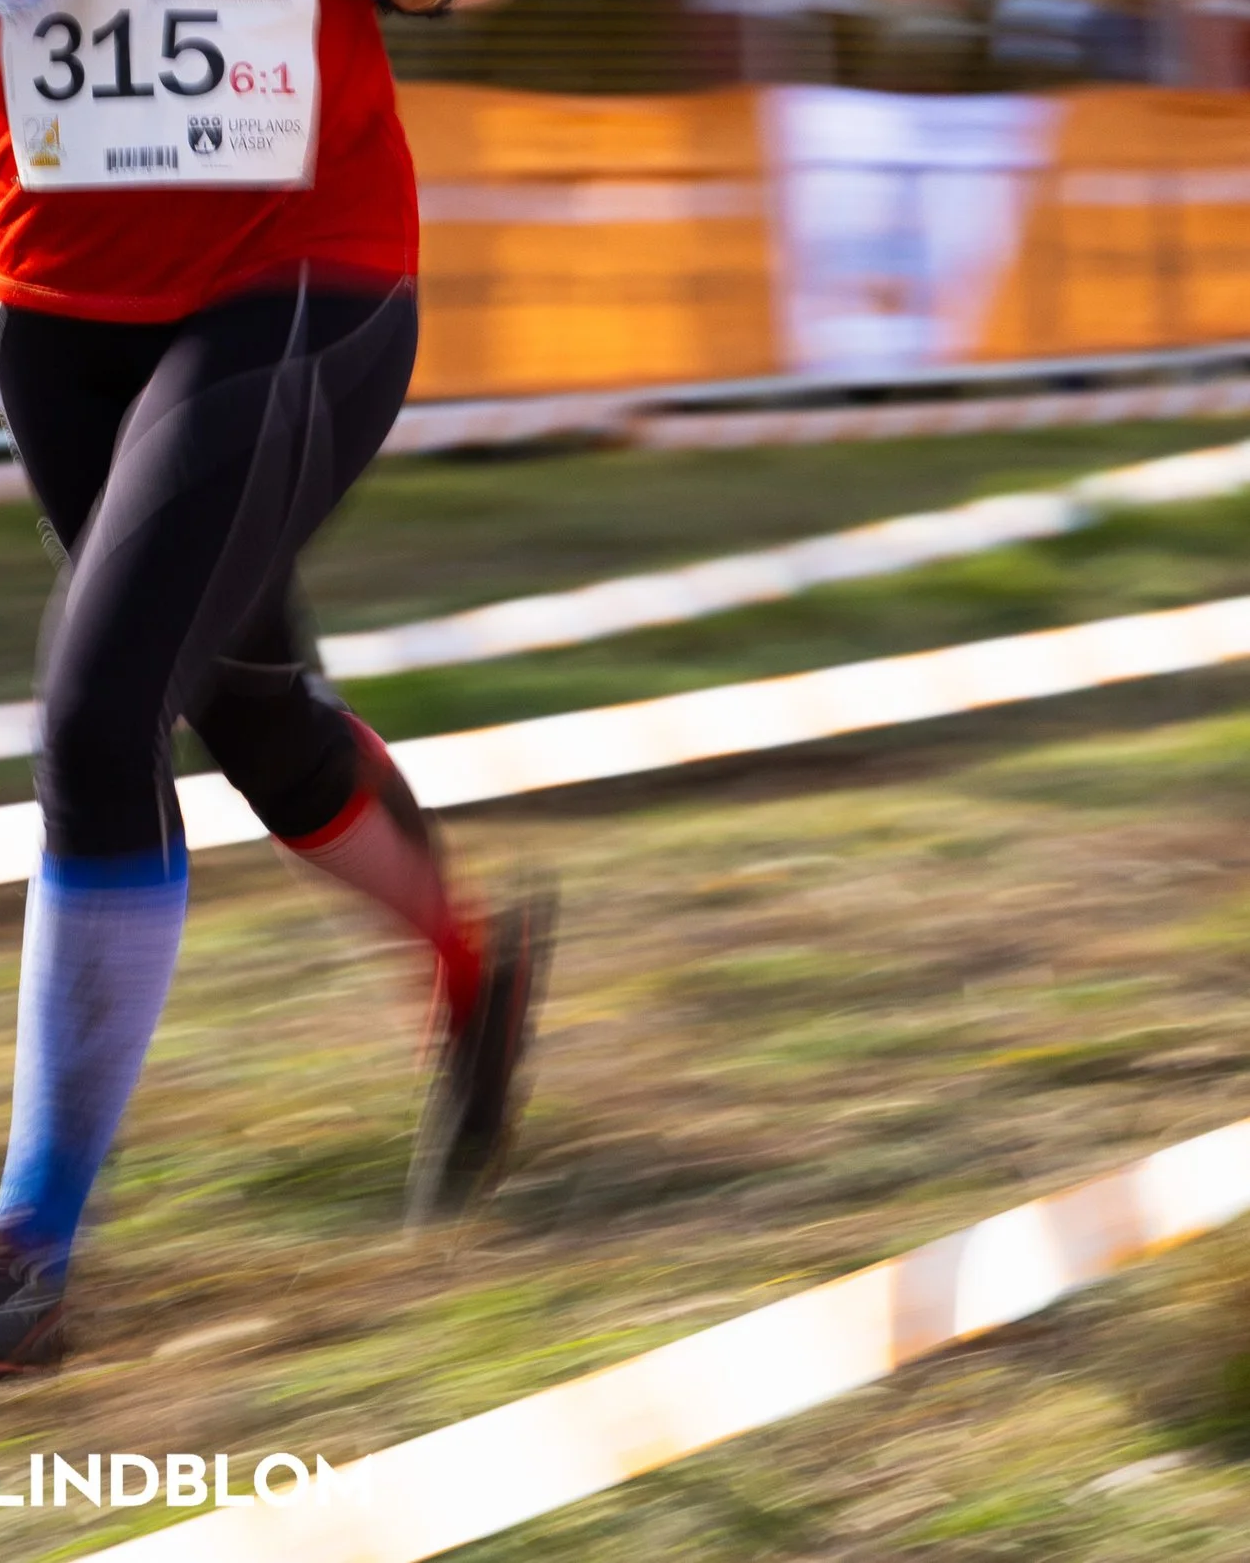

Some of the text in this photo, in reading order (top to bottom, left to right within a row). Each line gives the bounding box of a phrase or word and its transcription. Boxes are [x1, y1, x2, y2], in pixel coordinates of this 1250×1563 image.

[32, 8, 225, 101] 315
[229, 61, 295, 94] 6:1
[228, 118, 302, 135] UPPLANDS
[228, 132, 274, 151] VÄSBY
